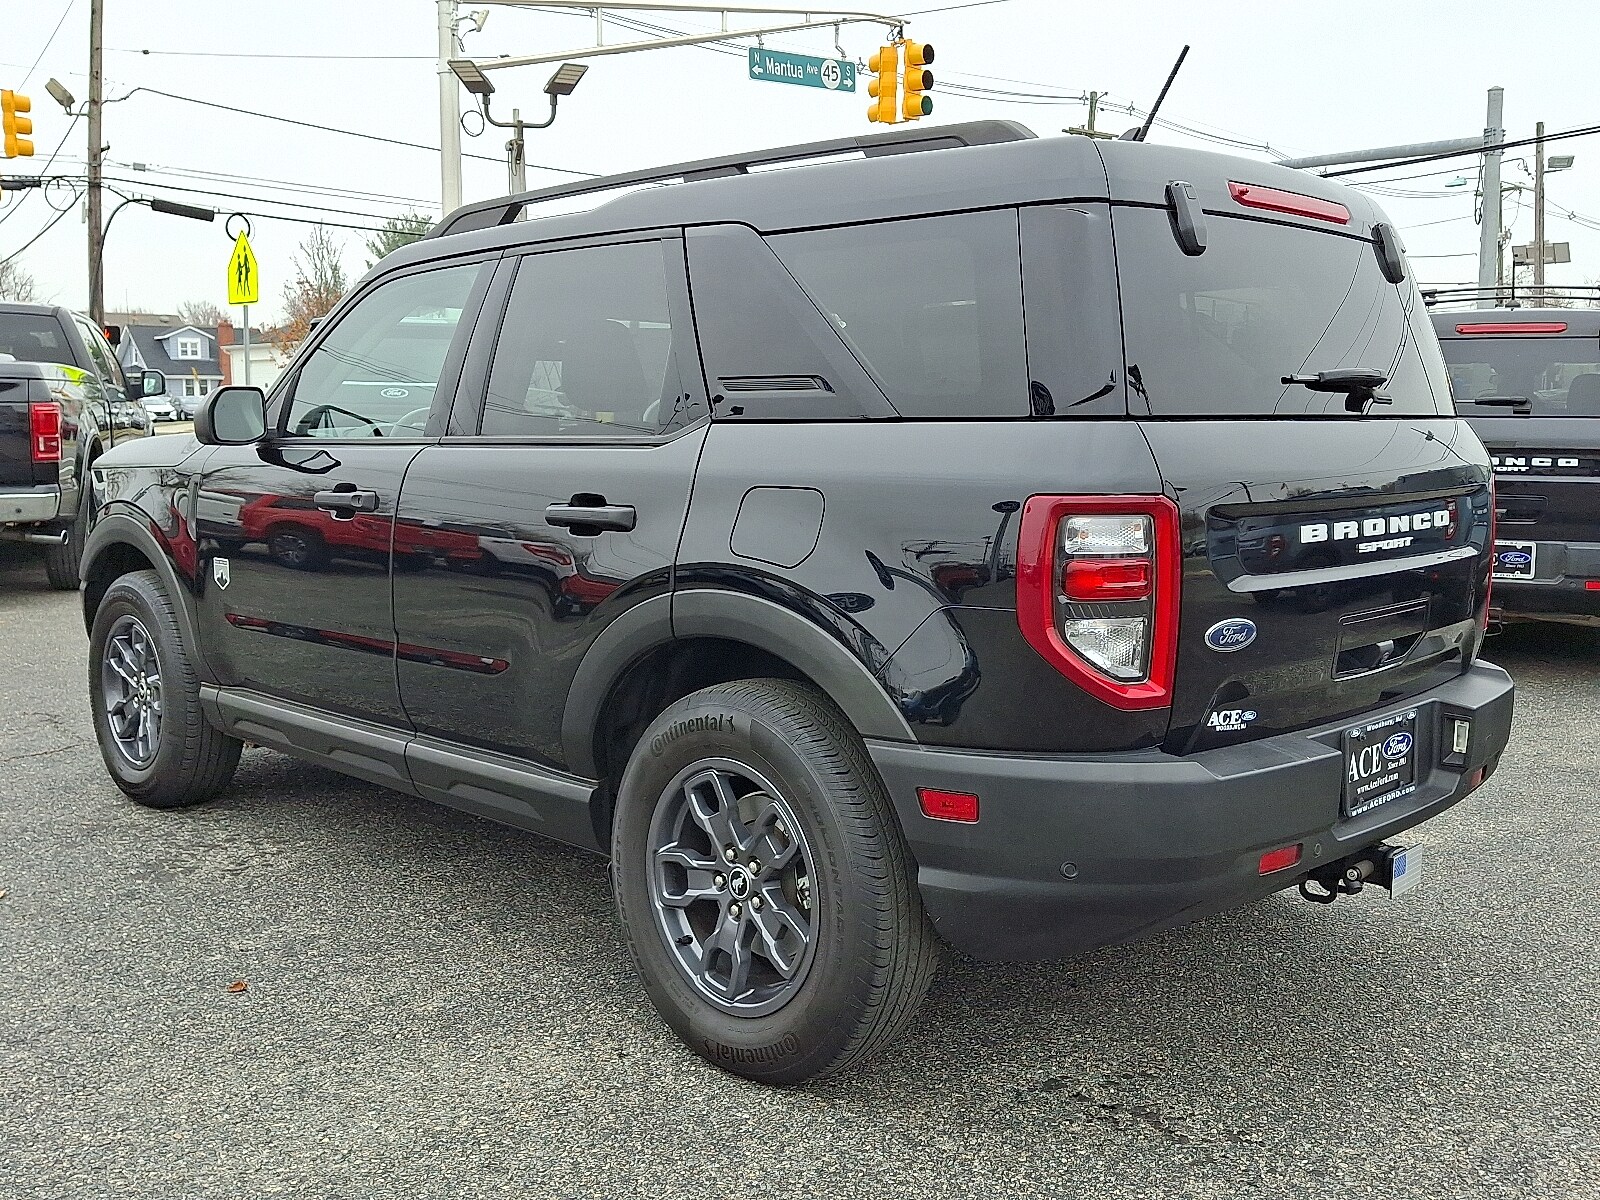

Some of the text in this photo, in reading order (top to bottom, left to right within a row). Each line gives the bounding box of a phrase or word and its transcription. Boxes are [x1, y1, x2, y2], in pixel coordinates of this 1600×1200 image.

[754, 52, 760, 63] N
[765, 56, 819, 79] Mantua Ave
[822, 65, 839, 82] 45
[845, 65, 851, 77] S
[1492, 457, 1578, 466] NCO
[1300, 510, 1450, 544] BRONCO
[1357, 536, 1414, 553] SPORT
[1220, 626, 1248, 644] Ford
[1207, 709, 1243, 727] ACE
[650, 713, 724, 757] Continental
[1348, 736, 1407, 784] ACE Ford
[715, 1029, 800, 1064] Continental
